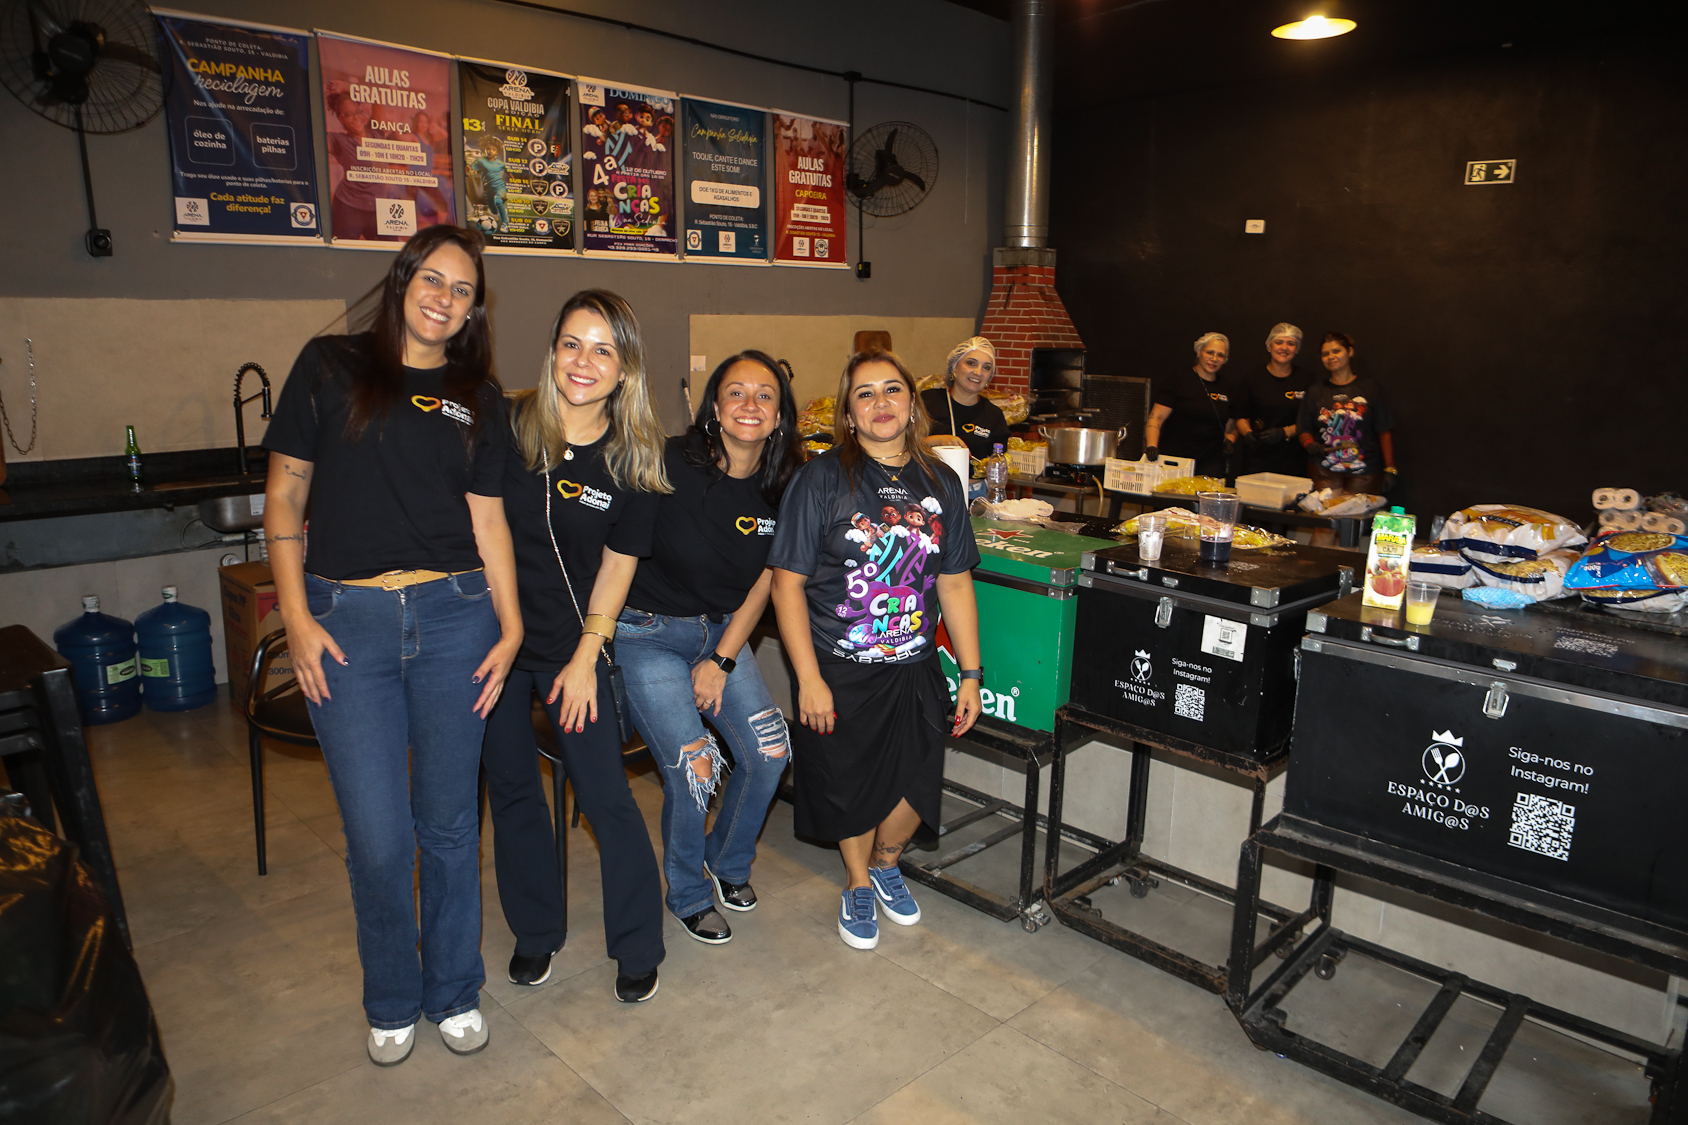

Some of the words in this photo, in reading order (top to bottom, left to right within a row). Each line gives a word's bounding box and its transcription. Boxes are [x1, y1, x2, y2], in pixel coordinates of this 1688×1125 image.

[187, 58, 285, 84] CAMPANHA
[365, 65, 410, 88] AULAS
[194, 74, 284, 105] reciclagem
[349, 83, 427, 110] GRATUITAS
[502, 85, 533, 95] ARENA
[609, 88, 670, 105] DOMINGO
[193, 99, 207, 107] Nos
[208, 100, 226, 110] ajude
[236, 105, 274, 115] arrecadação
[487, 97, 509, 110] COPA
[510, 100, 545, 115] VALDIBIA
[370, 119, 412, 135] DANÇA
[463, 118, 482, 131] 13
[495, 114, 544, 131] FINAL
[193, 129, 213, 140] óleo
[214, 131, 226, 141] de
[256, 135, 290, 146] baterias
[193, 139, 227, 150] cozinha
[261, 145, 287, 154] pilhas
[364, 141, 391, 150] SEGUNDAS
[396, 145, 419, 153] QUARTAS
[692, 151, 714, 162] TOQUE,
[714, 154, 733, 164] CANTE
[738, 157, 758, 167] DANCE
[797, 156, 824, 172] AULAS
[350, 165, 382, 174] INSCRIÇÕES
[711, 163, 725, 172] ESTE
[355, 173, 385, 181] SEBASTIÃO
[788, 169, 833, 188] GRATUITAS
[210, 192, 235, 202] Cada
[236, 194, 269, 204] atitude
[270, 196, 285, 205] faz
[613, 182, 652, 200] CRIA
[795, 189, 827, 200] CAPOEIRA
[226, 203, 272, 215] diferença!
[384, 219, 409, 227] ARENA
[582, 485, 613, 502] Projeto
[877, 487, 909, 495] ARENA
[579, 493, 611, 509] Adonai
[838, 606, 848, 614] 12
[869, 593, 917, 616] CRIA
[877, 627, 915, 639] ARENA
[880, 635, 913, 644] VALDIBIA
[1171, 657, 1202, 671] Siga-nos
[1203, 665, 1213, 674] no
[1173, 668, 1211, 684] Instagram!
[1122, 691, 1156, 707] AMIG@S
[1147, 689, 1166, 700] D@S
[1508, 746, 1571, 771] Siga-nos
[1573, 763, 1594, 776] no
[1510, 765, 1590, 794] Instagram!
[1387, 781, 1449, 808] ESPAÇO
[1453, 798, 1490, 819] D@S
[1401, 802, 1470, 831] AMIG@S
